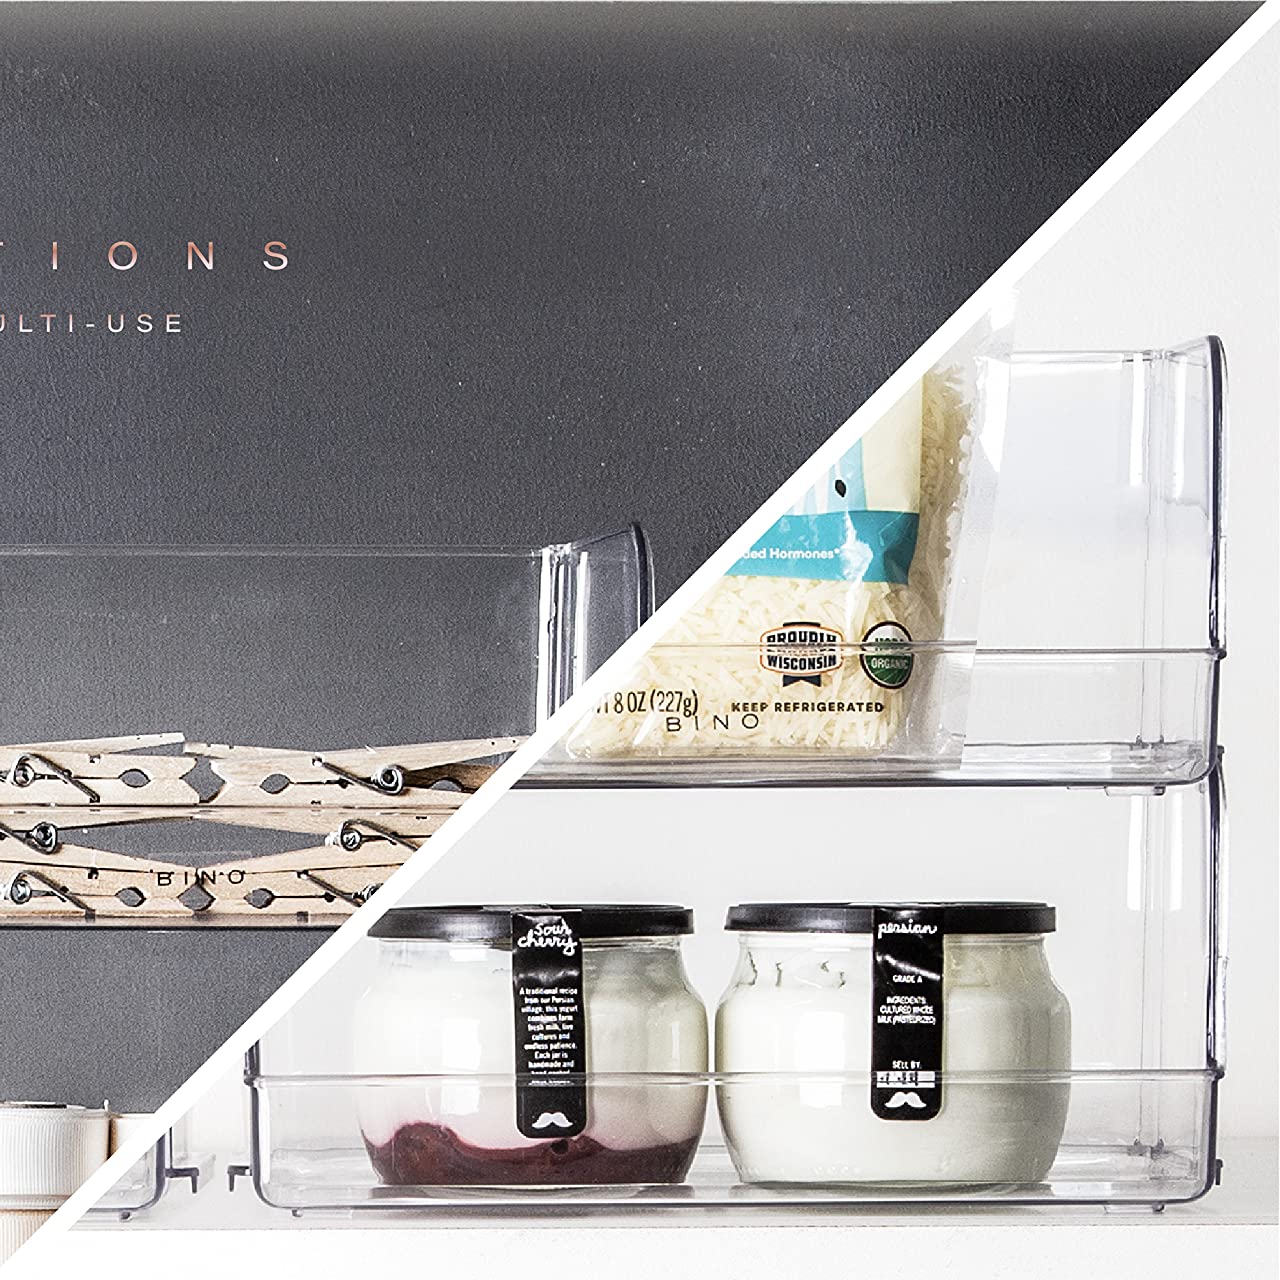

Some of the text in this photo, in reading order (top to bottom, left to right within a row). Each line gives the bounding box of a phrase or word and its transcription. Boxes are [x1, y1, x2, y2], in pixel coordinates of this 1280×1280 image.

[767, 655, 837, 670] WISCONSIN
[871, 656, 909, 669] ORGANIC
[614, 691, 624, 714] 8
[627, 691, 647, 713] OZ
[649, 688, 699, 718] (227g)
[731, 702, 884, 713] KEEP REFRIGERATED
[666, 713, 759, 732] BINO
[156, 868, 246, 887] BINO
[877, 919, 938, 939] persian
[893, 975, 916, 984] GRADE
